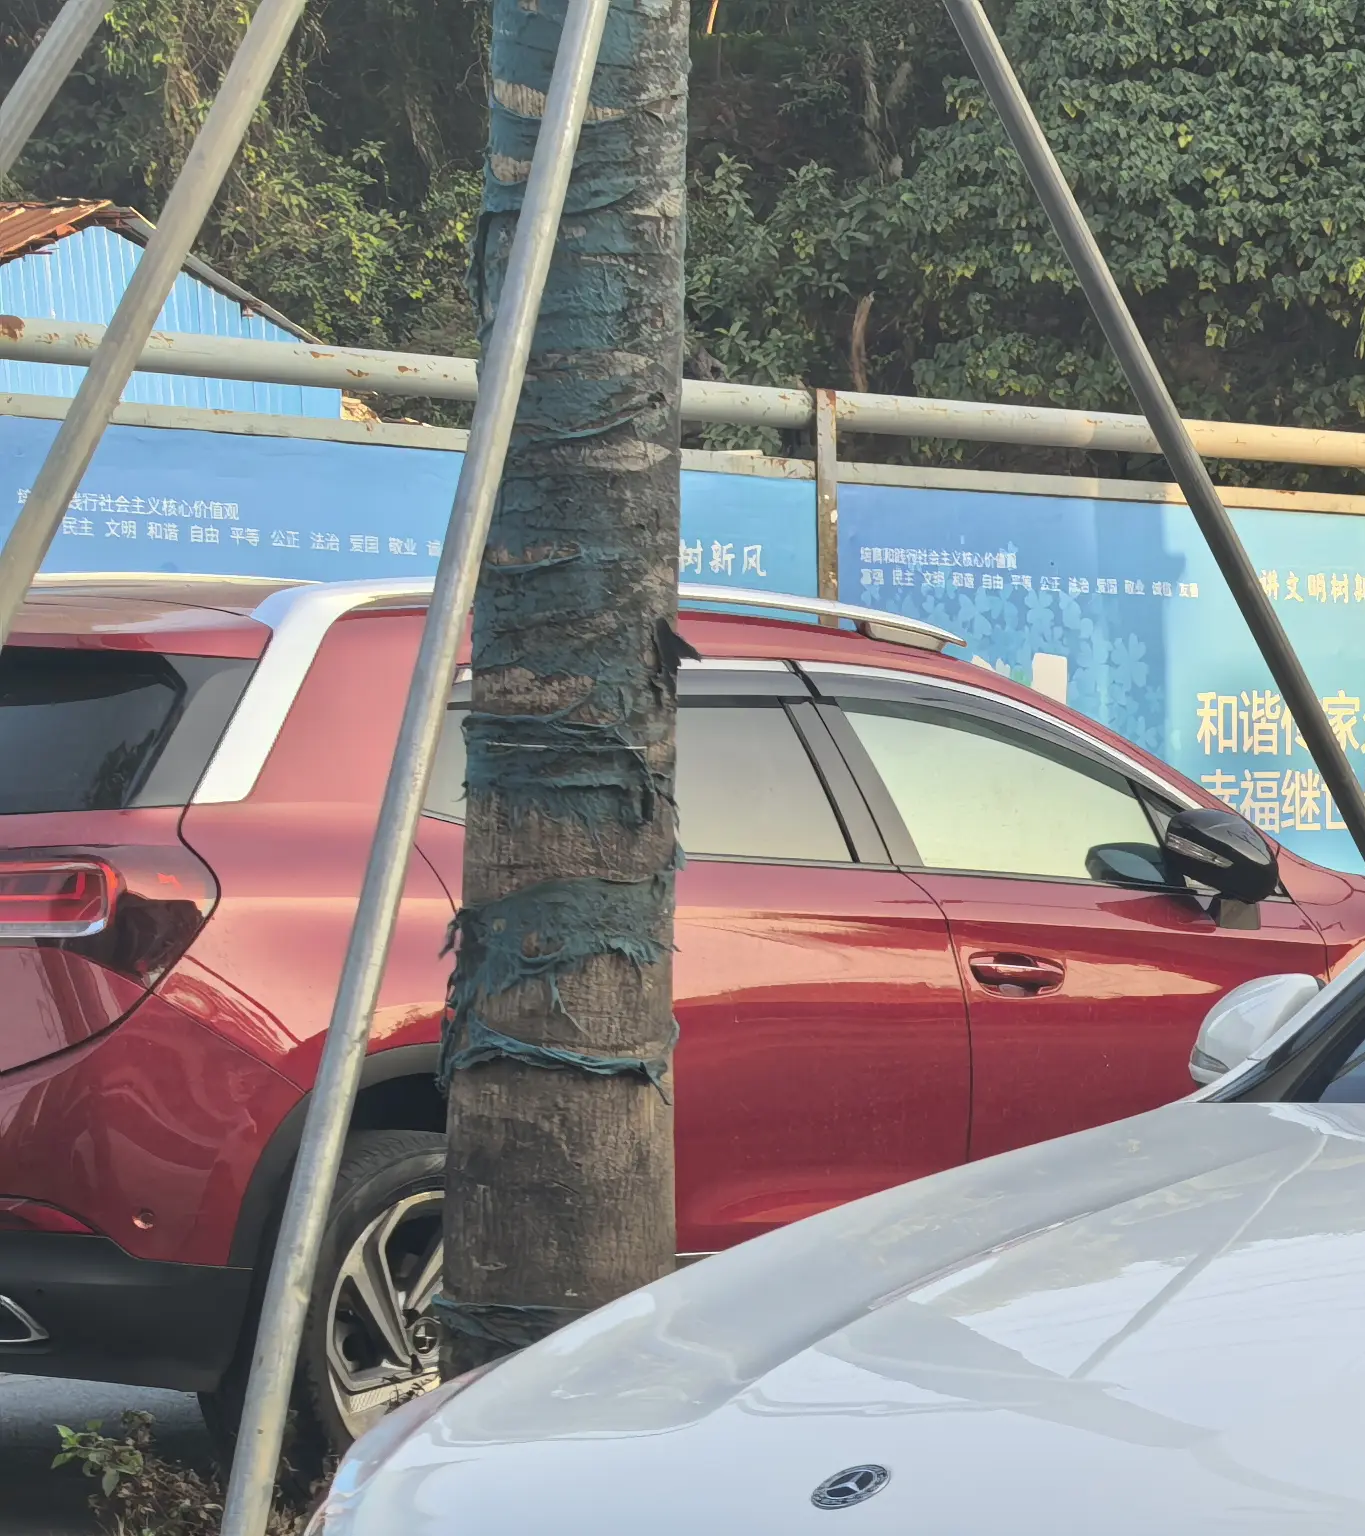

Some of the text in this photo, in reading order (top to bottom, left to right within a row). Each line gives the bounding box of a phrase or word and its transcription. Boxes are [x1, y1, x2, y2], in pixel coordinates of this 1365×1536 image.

[17, 488, 239, 520] 培践行社会主义核心价值观
[62, 515, 94, 536] 民主
[105, 518, 136, 539] 文明
[147, 521, 179, 541] 和谐
[190, 524, 219, 544] 自由
[230, 526, 260, 546] 平等
[270, 529, 300, 548] 公正
[310, 531, 339, 551] 法治
[350, 534, 379, 553] 爱国
[389, 537, 417, 556] 敬业
[679, 538, 766, 577] 树新风
[892, 569, 915, 587] 民主
[982, 574, 1003, 590] 自由
[1040, 576, 1061, 592] 公正
